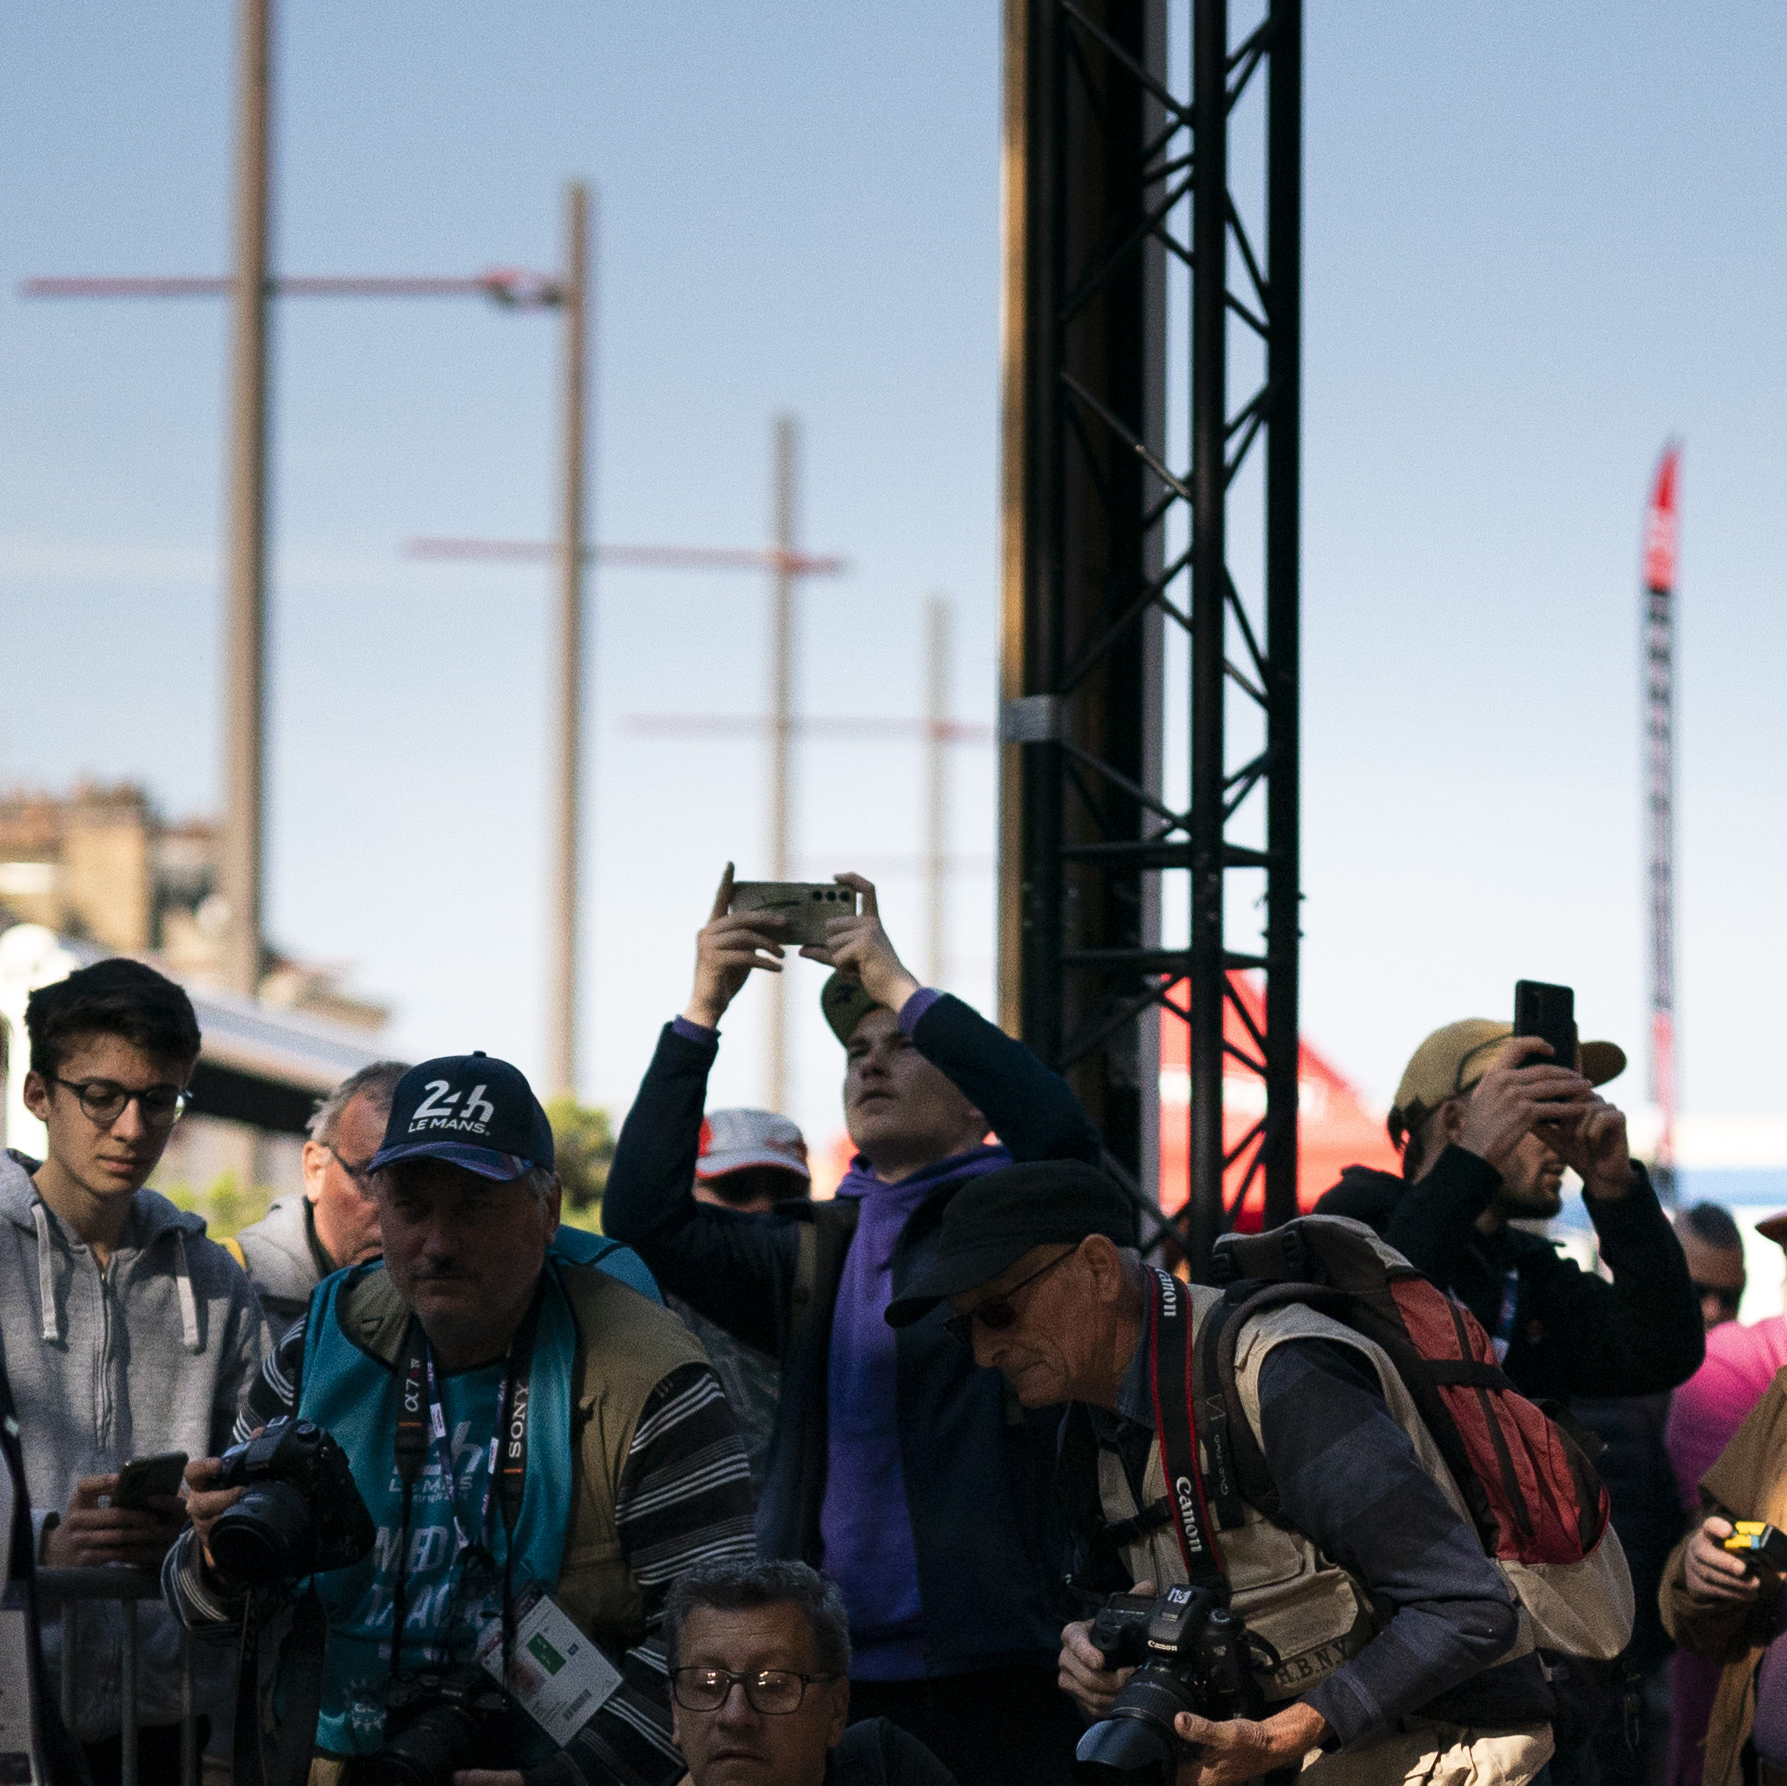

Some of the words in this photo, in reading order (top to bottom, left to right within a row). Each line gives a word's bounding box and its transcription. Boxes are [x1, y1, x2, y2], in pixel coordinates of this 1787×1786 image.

[412, 1079, 495, 1123] 24h
[407, 1118, 430, 1133] LE
[428, 1117, 487, 1134] MANS
[508, 1379, 529, 1459] SONY
[1176, 1476, 1203, 1553] Canon
[1147, 1640, 1178, 1652] Canon
